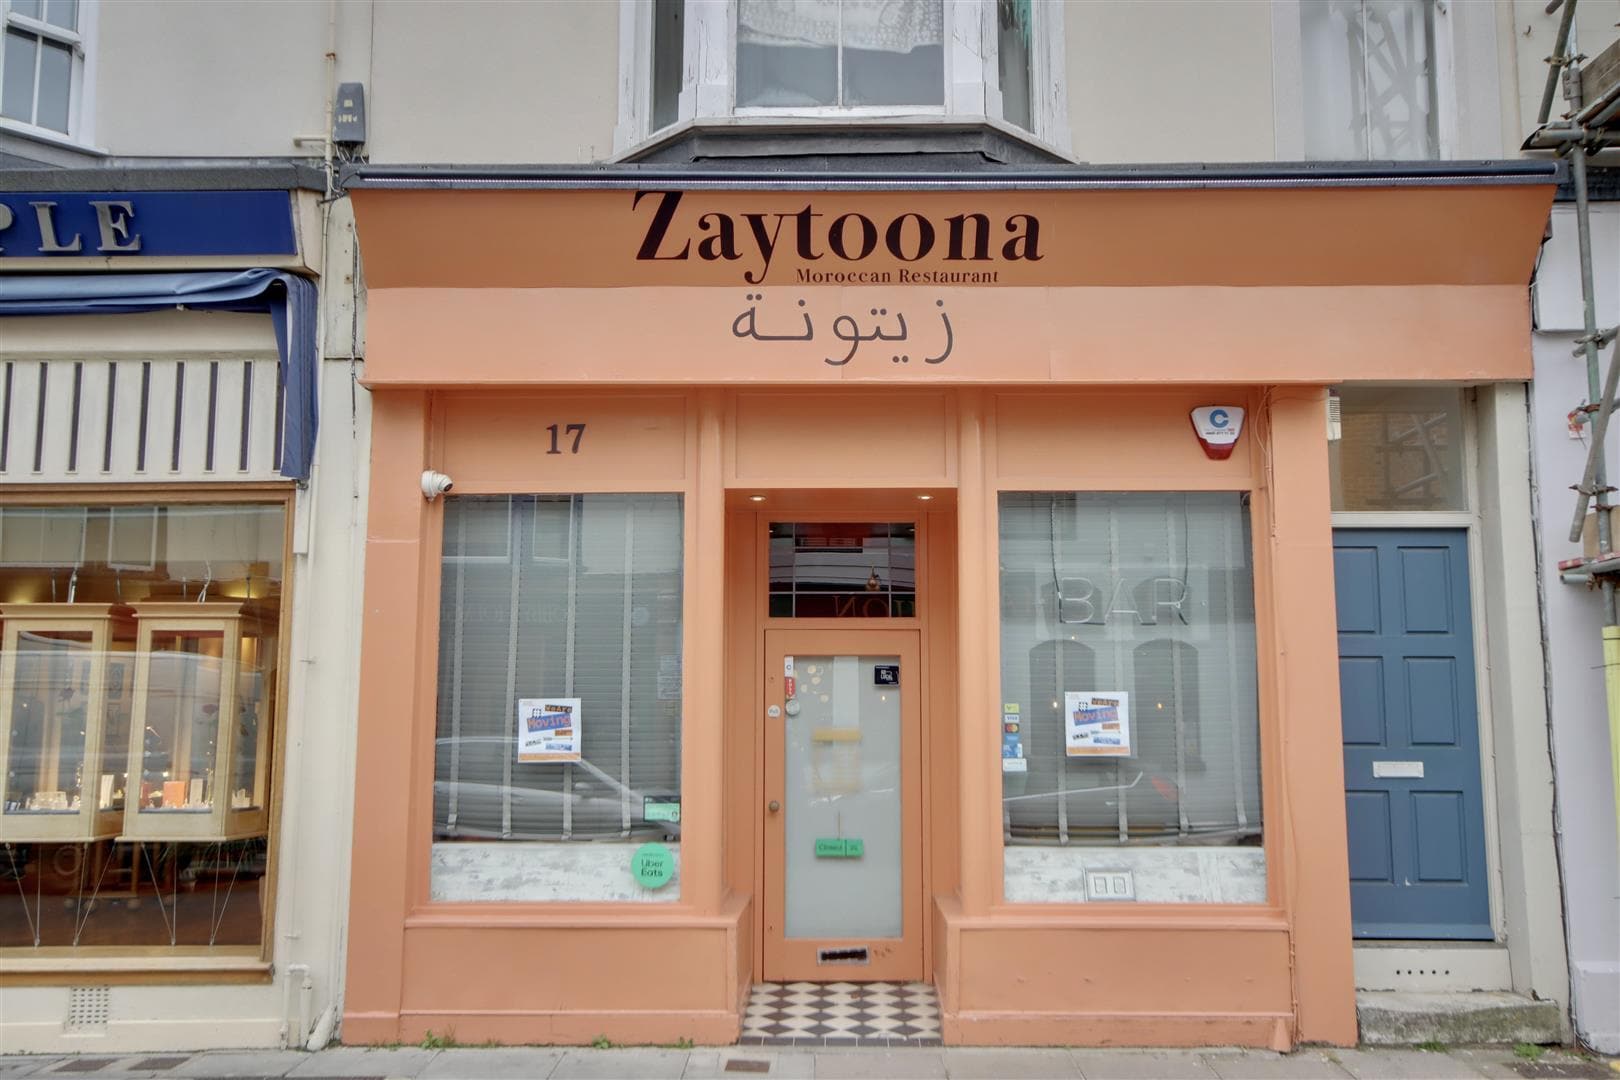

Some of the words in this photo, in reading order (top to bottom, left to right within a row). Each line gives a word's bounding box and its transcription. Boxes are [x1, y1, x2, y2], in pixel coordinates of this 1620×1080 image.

[632, 190, 1044, 284] Zaytoona
[796, 268, 891, 283] Moroccan
[899, 268, 999, 283] Restaurant
[732, 293, 954, 365] زيتونة
[546, 423, 586, 454] 17
[1061, 576, 1188, 625] BAR
[528, 714, 571, 729] Moving
[640, 868, 664, 878] Eats
[641, 858, 664, 868] Uber
